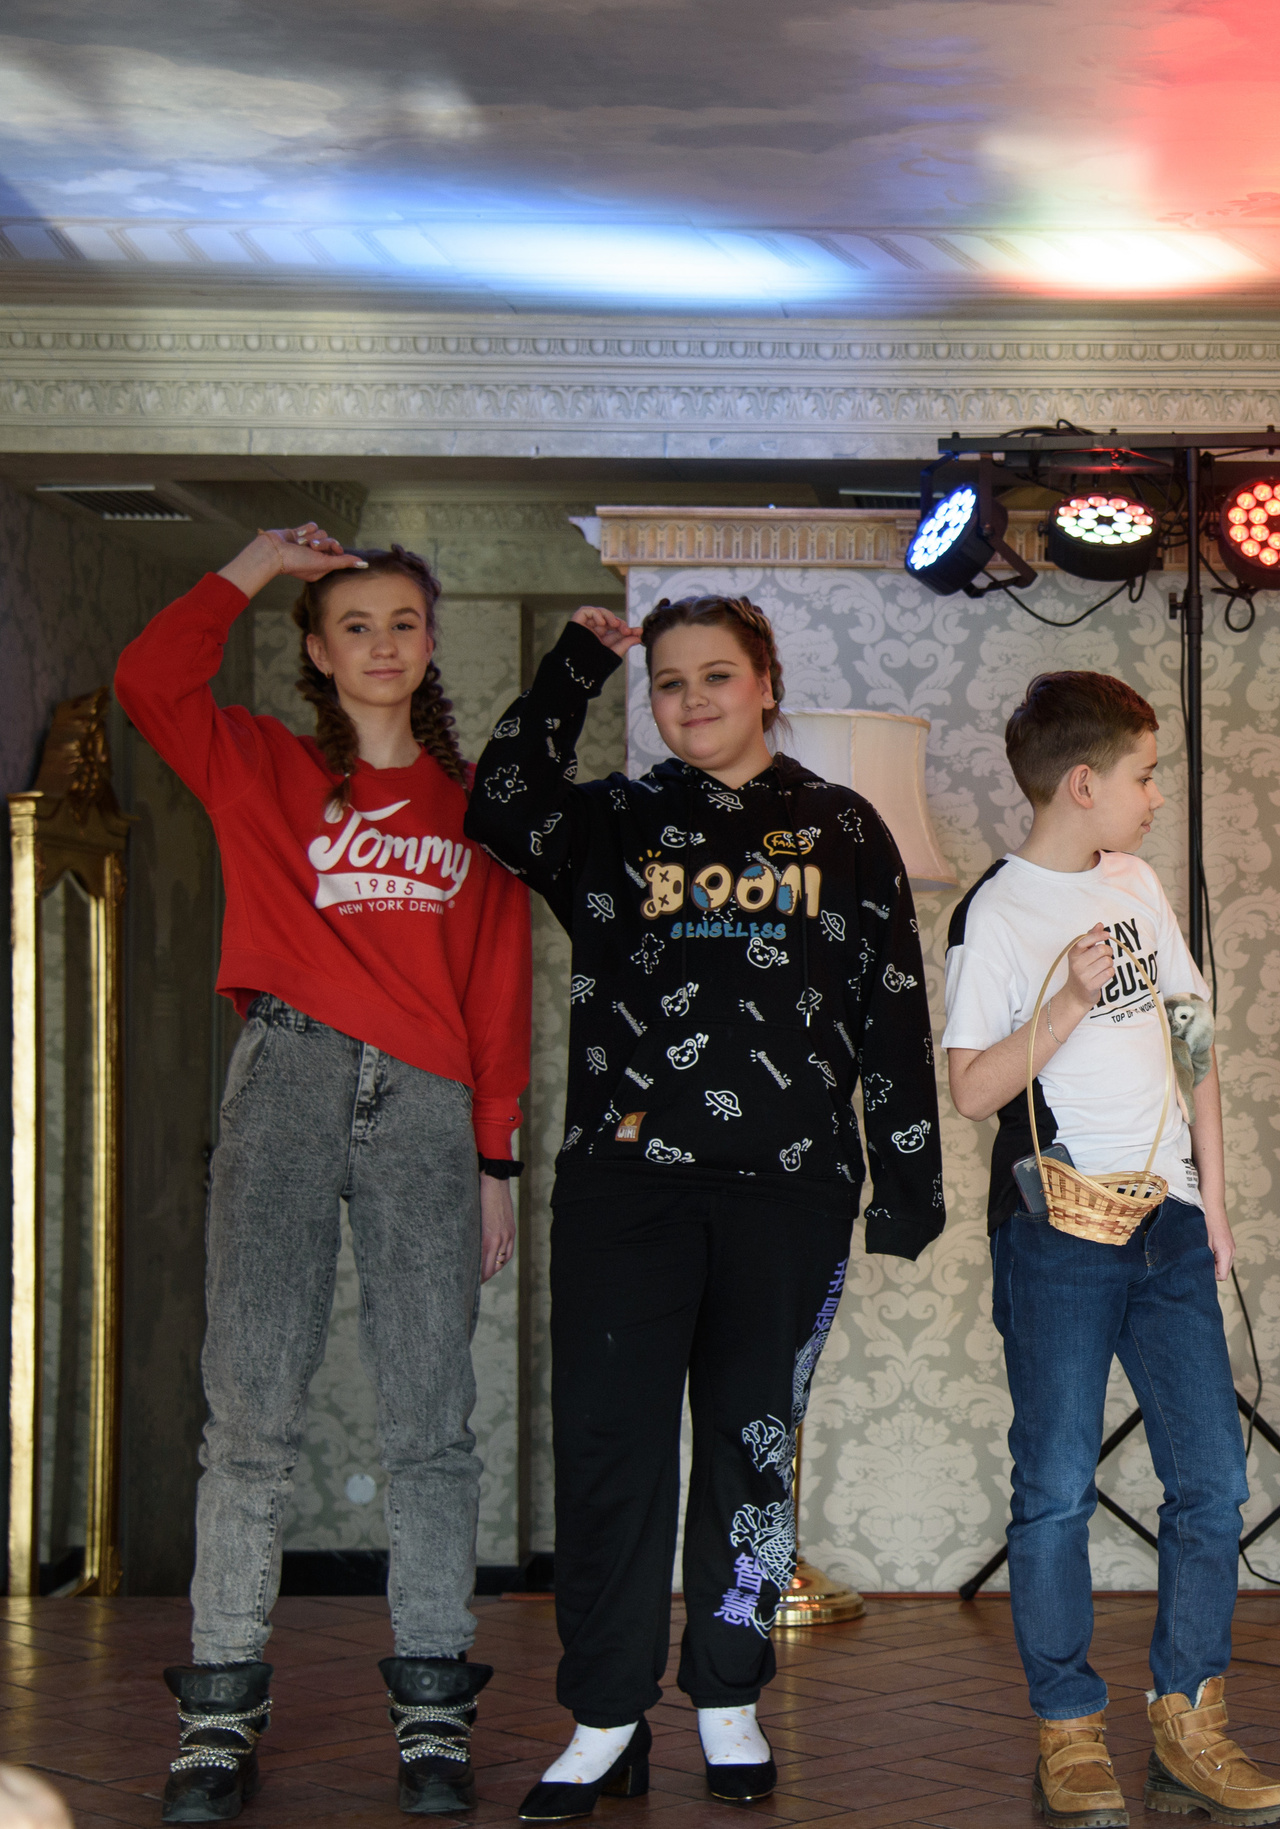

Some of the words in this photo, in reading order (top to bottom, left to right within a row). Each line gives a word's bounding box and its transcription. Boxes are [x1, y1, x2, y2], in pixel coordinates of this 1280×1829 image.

[308, 799, 472, 900] Tommy
[354, 879, 415, 896] 1985
[338, 903, 364, 916] NEW
[367, 900, 405, 912] YORK
[670, 921, 787, 940] SENSELESS
[1111, 1012, 1126, 1023] TOP
[713, 1552, 768, 1627] 智慧
